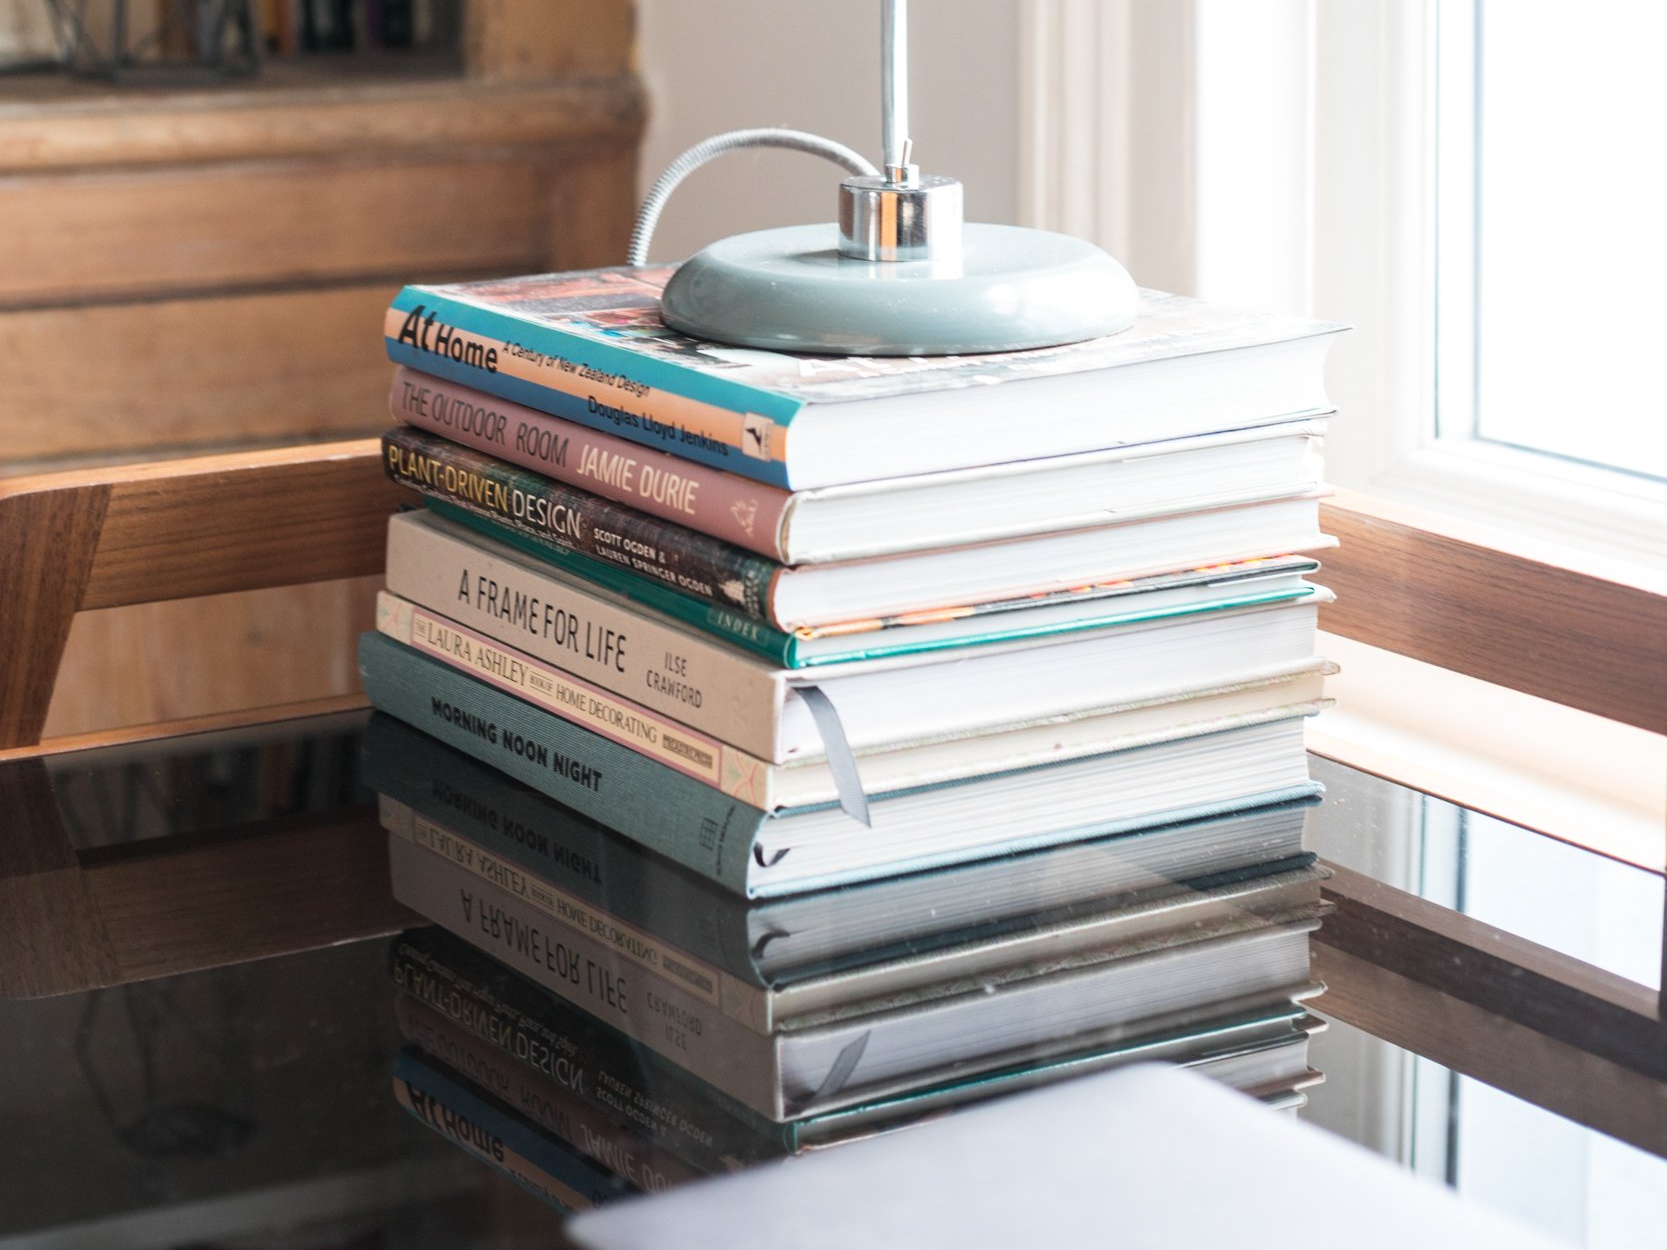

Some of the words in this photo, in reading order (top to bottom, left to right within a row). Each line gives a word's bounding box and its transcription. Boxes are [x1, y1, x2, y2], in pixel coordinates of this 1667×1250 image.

[398, 304, 437, 353] At
[435, 325, 499, 374] Home
[502, 340, 512, 352] A
[512, 342, 543, 367] Century
[545, 354, 559, 367] of
[557, 357, 577, 374] New
[578, 363, 618, 386] Zealand
[617, 374, 651, 398] Design
[402, 382, 430, 417] THE
[431, 394, 507, 448] OUTDOOR
[516, 422, 570, 468] ROOM
[588, 395, 640, 428] Douglas
[642, 412, 676, 440] Lloyd
[680, 424, 729, 456] Jenkins
[388, 445, 509, 513] PLANT-DRIVEN
[512, 490, 582, 540] DESIGN
[576, 444, 637, 493] JAMIE
[639, 465, 700, 516] DURIE
[593, 528, 623, 547] SCOTT
[623, 539, 656, 559] OGDEN
[658, 553, 666, 564] &
[595, 545, 631, 566] LAUREN
[632, 557, 677, 584] SPRINGER
[678, 575, 714, 597] OGDEN
[458, 569, 471, 605] A
[477, 575, 539, 635] FRAME
[543, 603, 579, 653] FOR
[585, 621, 628, 673] LIFE
[717, 611, 760, 641] INDEX
[427, 622, 473, 662] LAURA
[475, 643, 529, 687] ASHLEY
[556, 683, 587, 712] HOME
[588, 698, 658, 744] DECORATING
[646, 669, 703, 709] CRAWFORD
[664, 652, 688, 677] ILSE
[431, 697, 497, 745] MORNING
[503, 729, 549, 768] NOON
[553, 752, 603, 792] NIGHT
